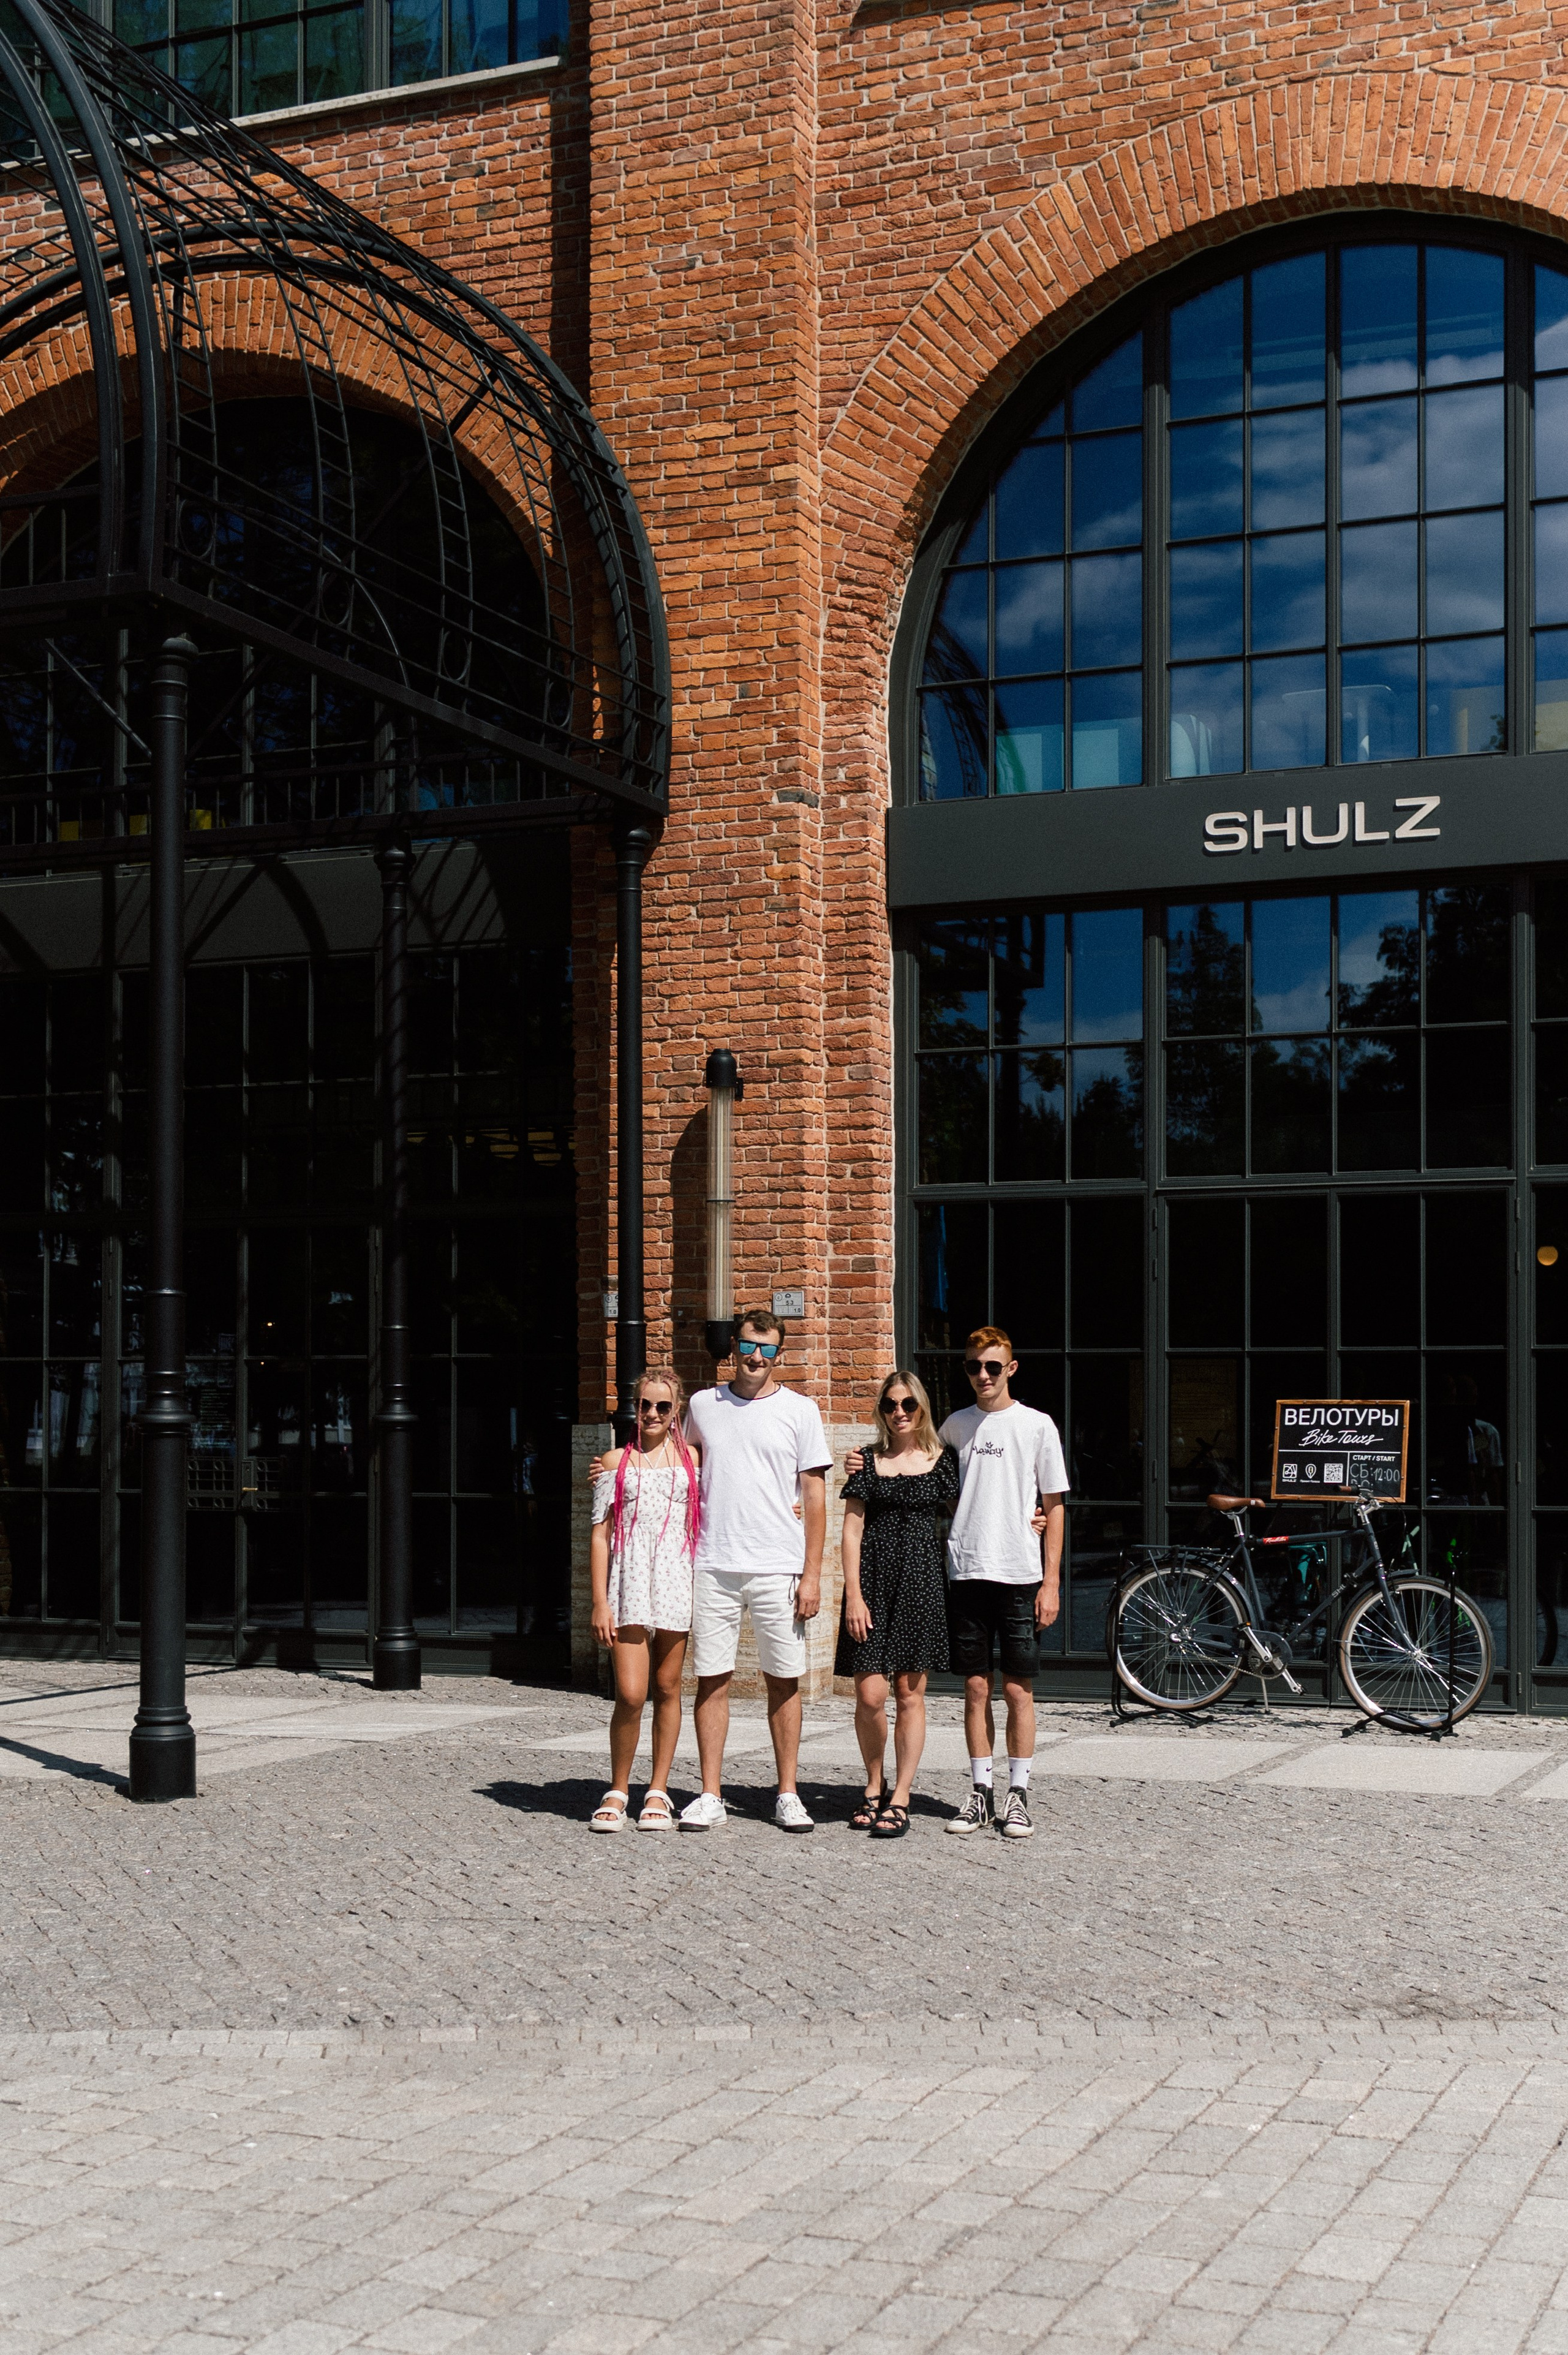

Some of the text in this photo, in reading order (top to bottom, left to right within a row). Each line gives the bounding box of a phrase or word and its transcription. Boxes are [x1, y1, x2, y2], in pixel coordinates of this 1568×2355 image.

[1204, 795, 1441, 852] SHULZ
[1284, 1408, 1399, 1426] ВЕЛОТУРЫ
[1298, 1429, 1384, 1446] Bike Tours
